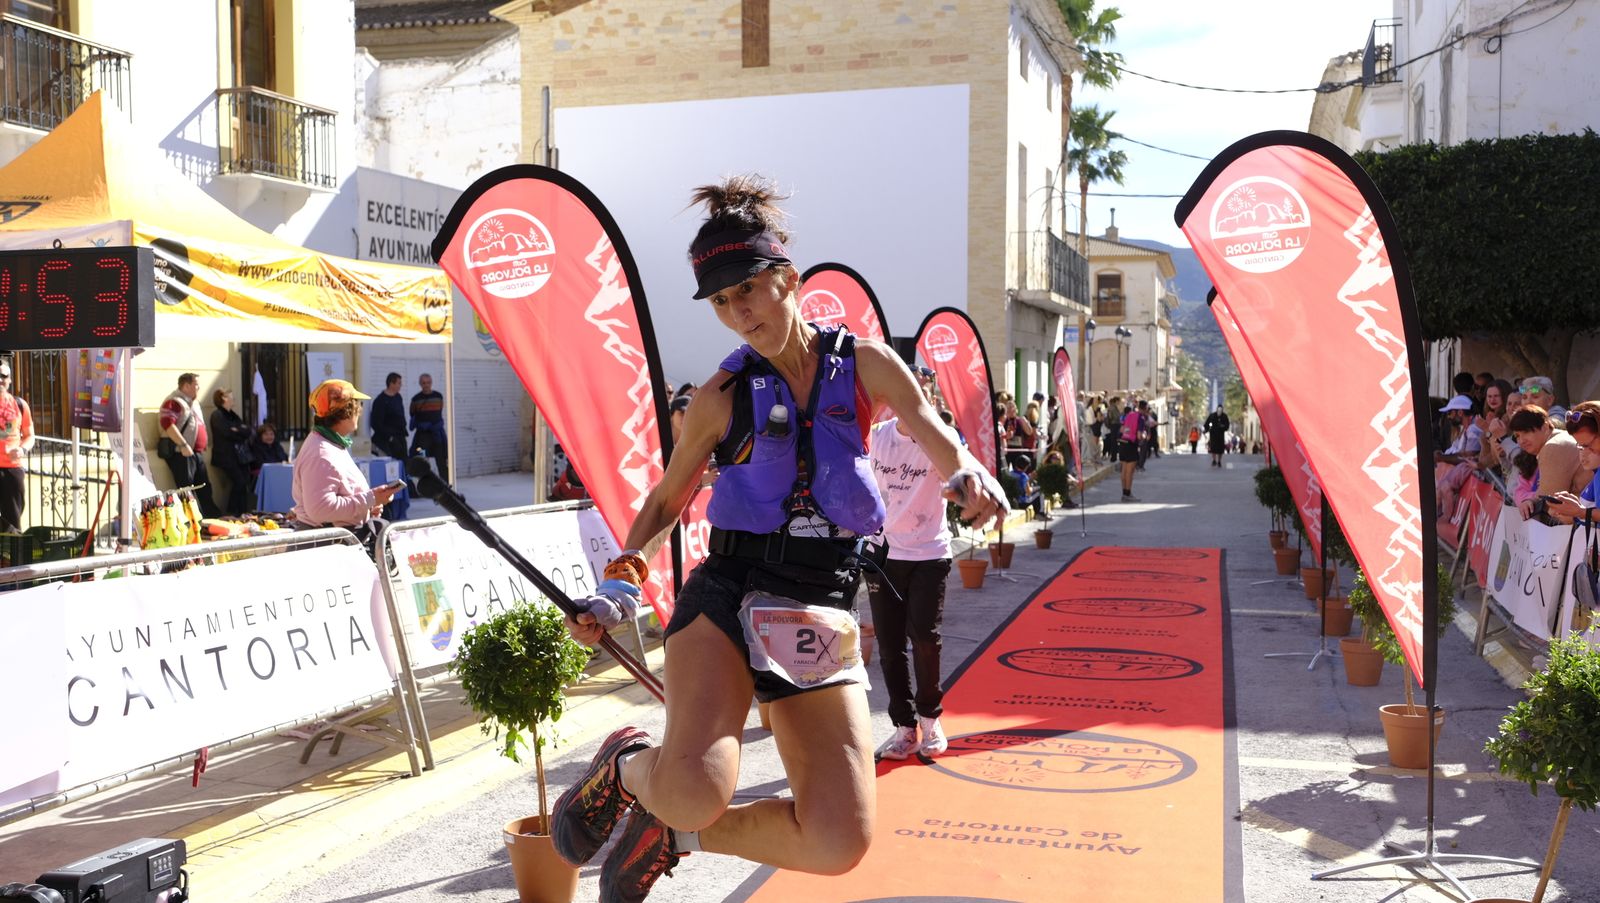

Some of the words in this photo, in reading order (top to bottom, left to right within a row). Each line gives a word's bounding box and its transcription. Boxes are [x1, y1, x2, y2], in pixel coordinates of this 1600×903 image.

[369, 236, 438, 265] AYUNTAM
[900, 463, 928, 482] Yepe
[590, 536, 609, 553] DE
[326, 584, 354, 609] DE
[796, 628, 816, 654] 2
[67, 615, 371, 727] CANTORIA
[993, 699, 1168, 713] Ayuntamiento
[1012, 694, 1115, 704] Cantoria
[963, 736, 1112, 754] POLVORA
[923, 818, 1069, 837] Cantoria
[1081, 831, 1123, 841] de
[894, 828, 1143, 856] Ayuntamiento
